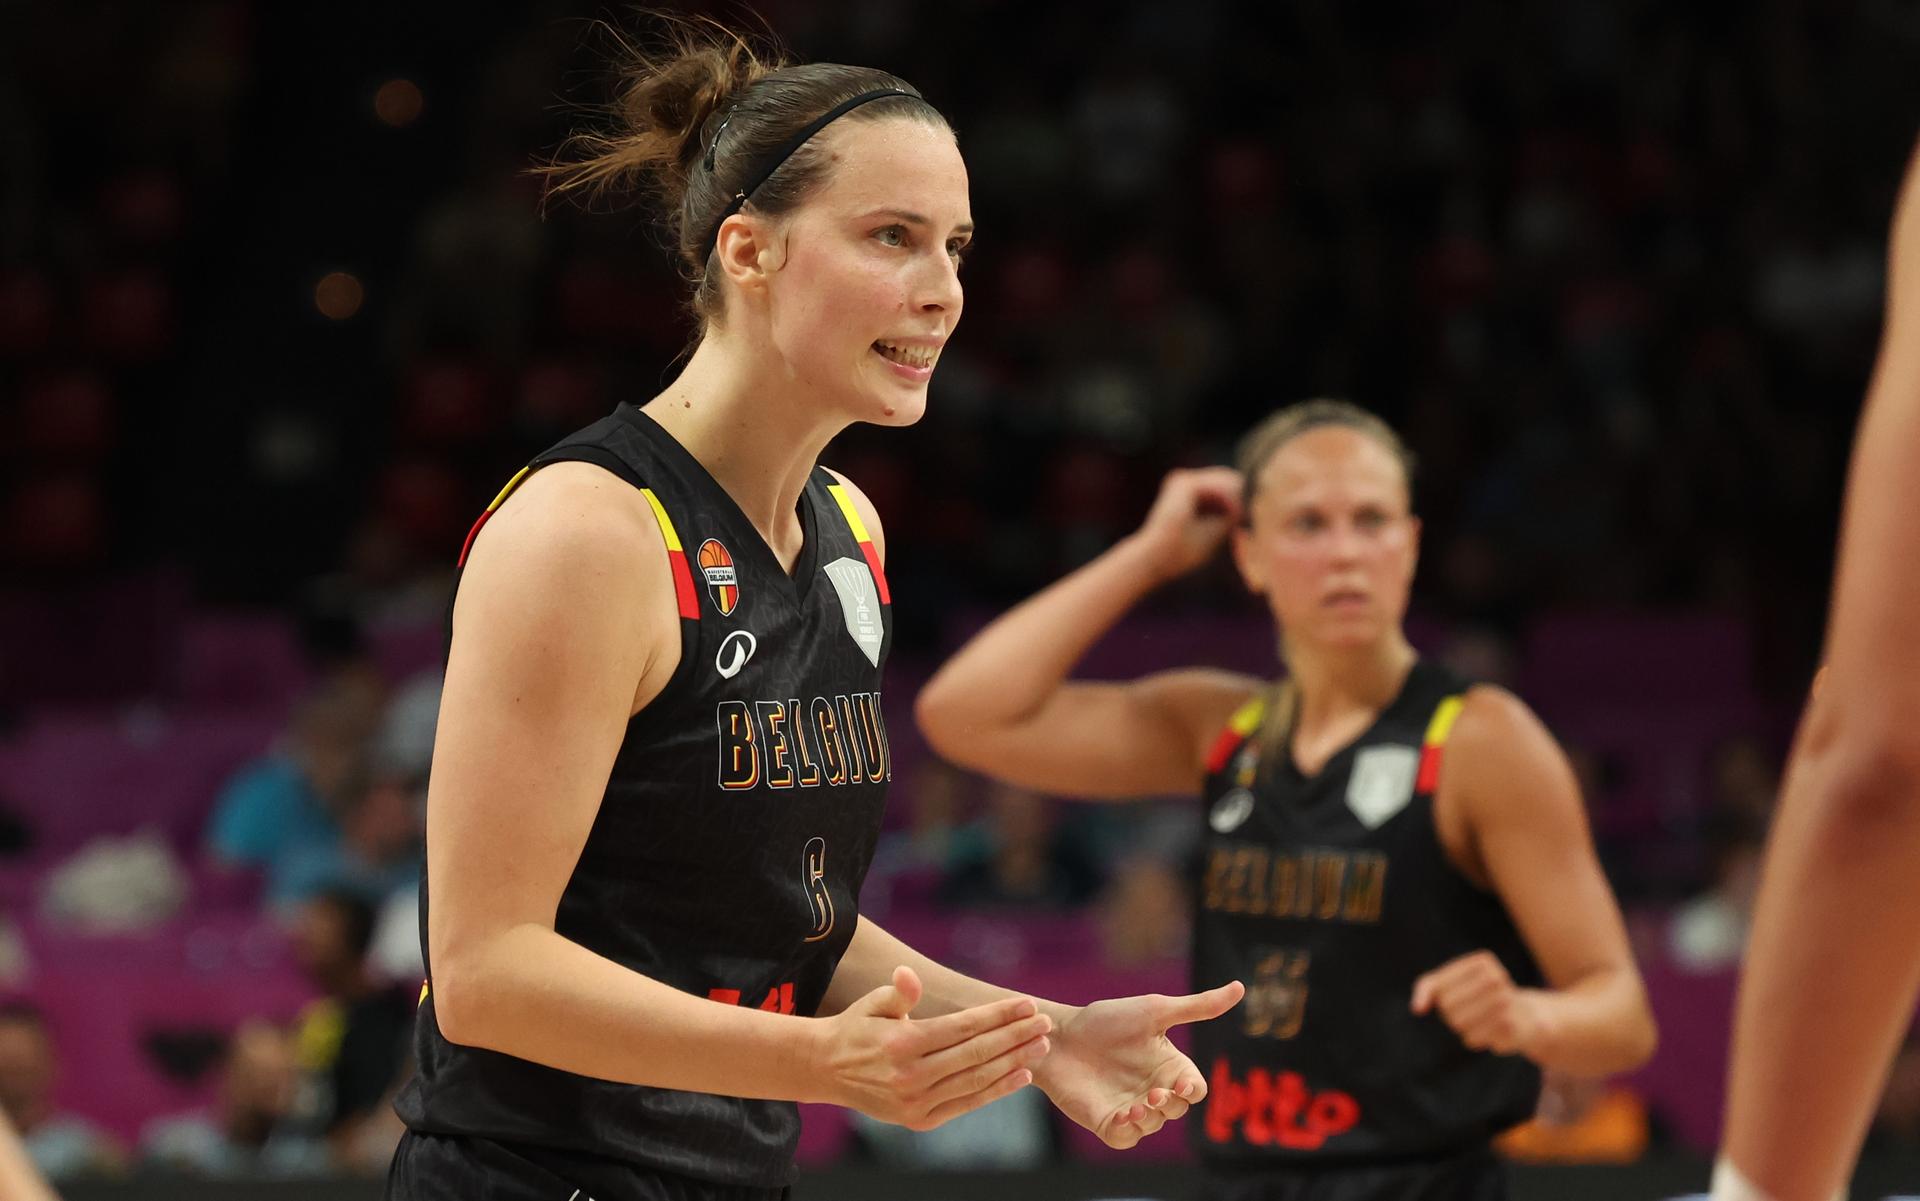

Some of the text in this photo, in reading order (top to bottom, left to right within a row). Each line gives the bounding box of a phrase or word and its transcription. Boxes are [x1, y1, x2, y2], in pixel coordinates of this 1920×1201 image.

[717, 692, 891, 790] BELGIU
[802, 836, 834, 943] 6
[1202, 846, 1389, 924] BELGIUM
